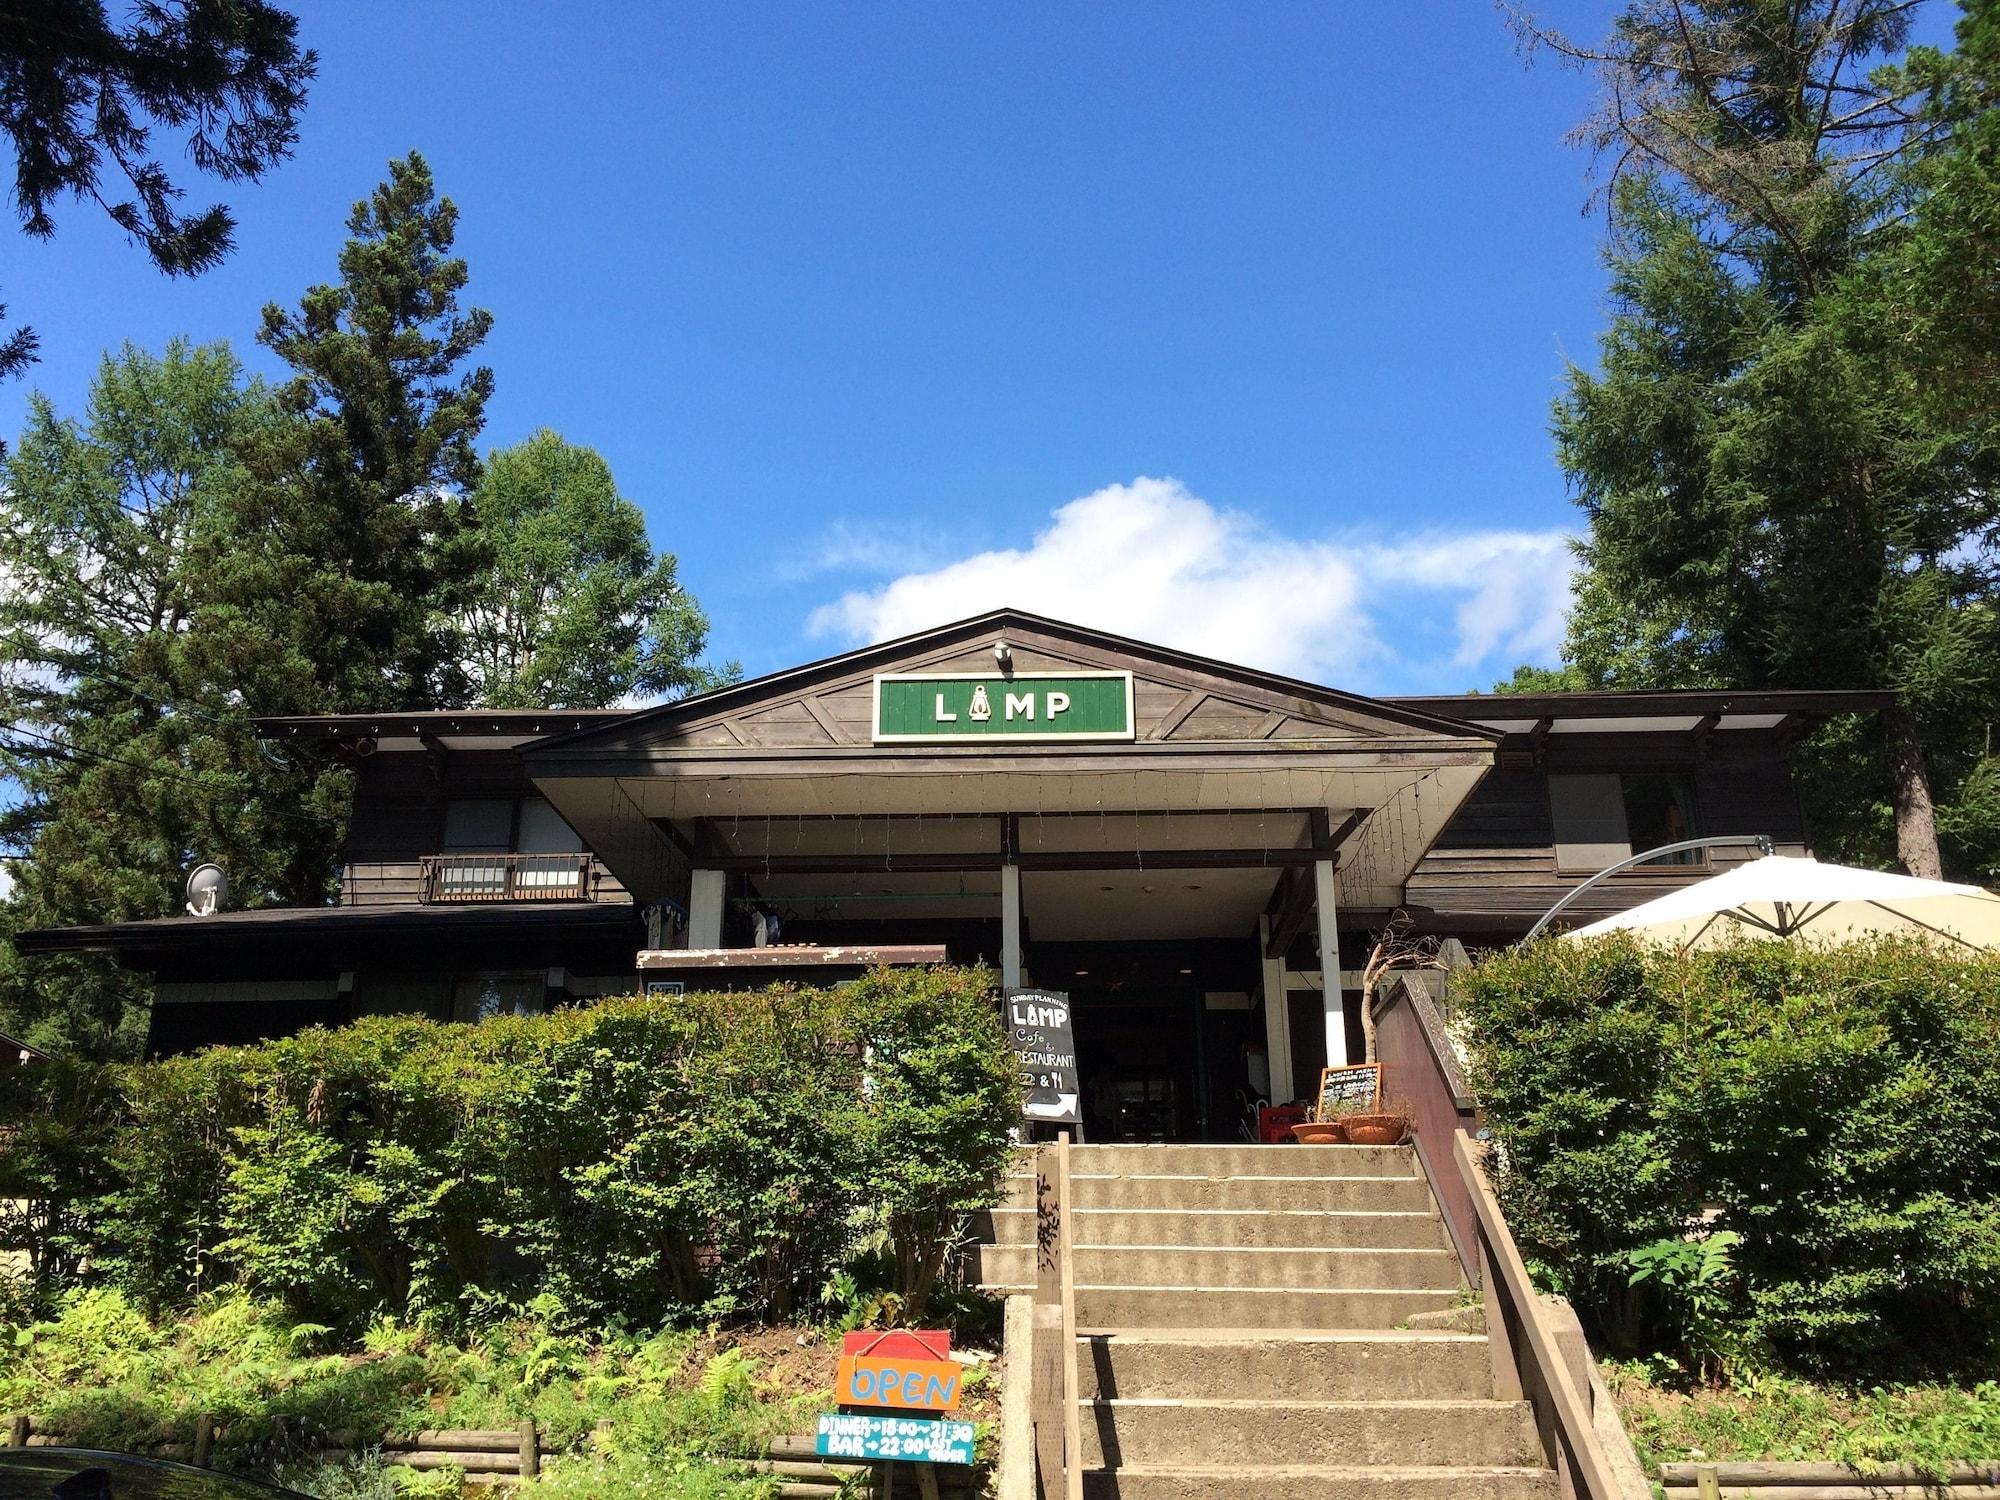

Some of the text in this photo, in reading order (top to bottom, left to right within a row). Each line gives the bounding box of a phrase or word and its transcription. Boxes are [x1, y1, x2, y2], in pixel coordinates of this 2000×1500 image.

[1010, 994, 1068, 1010] SUNDAY PLANNING
[1014, 1050, 1073, 1068] RESTAURANT
[1040, 1075, 1050, 1087] &
[851, 1368, 956, 1406] OPEN
[818, 1416, 871, 1438] DINNER
[828, 1435, 924, 1457] BAR 22:00
[924, 1437, 953, 1450] LAST
